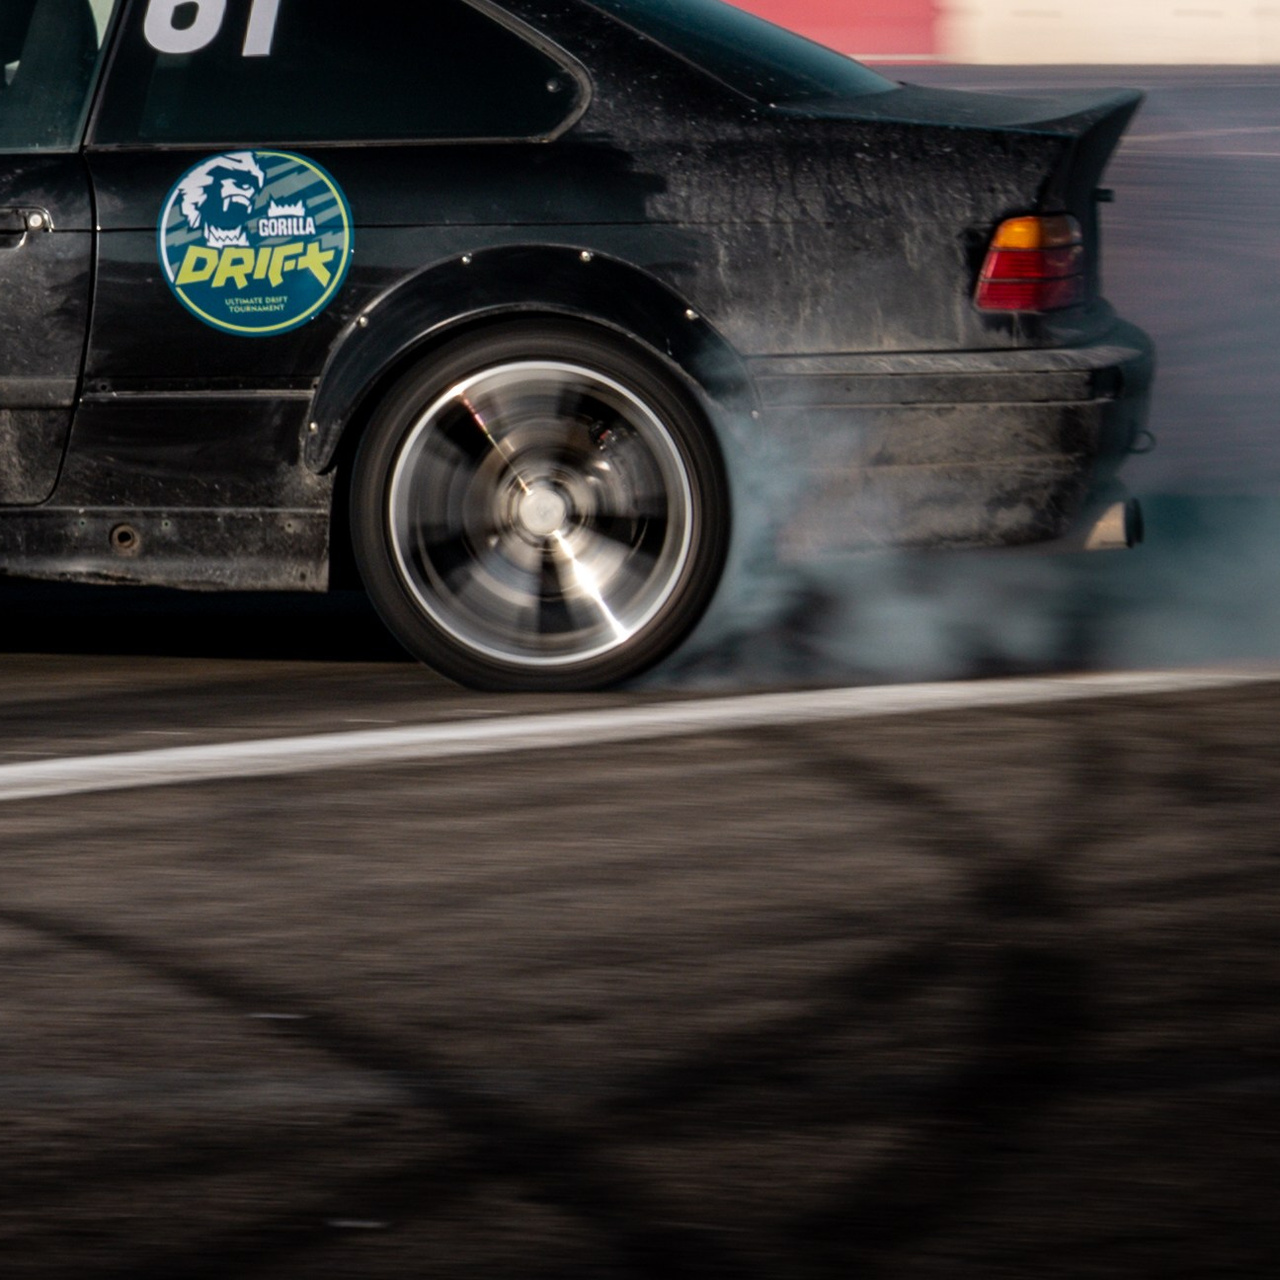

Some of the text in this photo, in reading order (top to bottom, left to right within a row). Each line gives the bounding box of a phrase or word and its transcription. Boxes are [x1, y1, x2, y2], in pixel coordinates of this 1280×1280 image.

[258, 216, 316, 236] GORILLA
[175, 241, 336, 289] DRIFT
[225, 296, 288, 306] ULTIMATE DRIFT
[229, 304, 285, 313] TOURNAMENT
